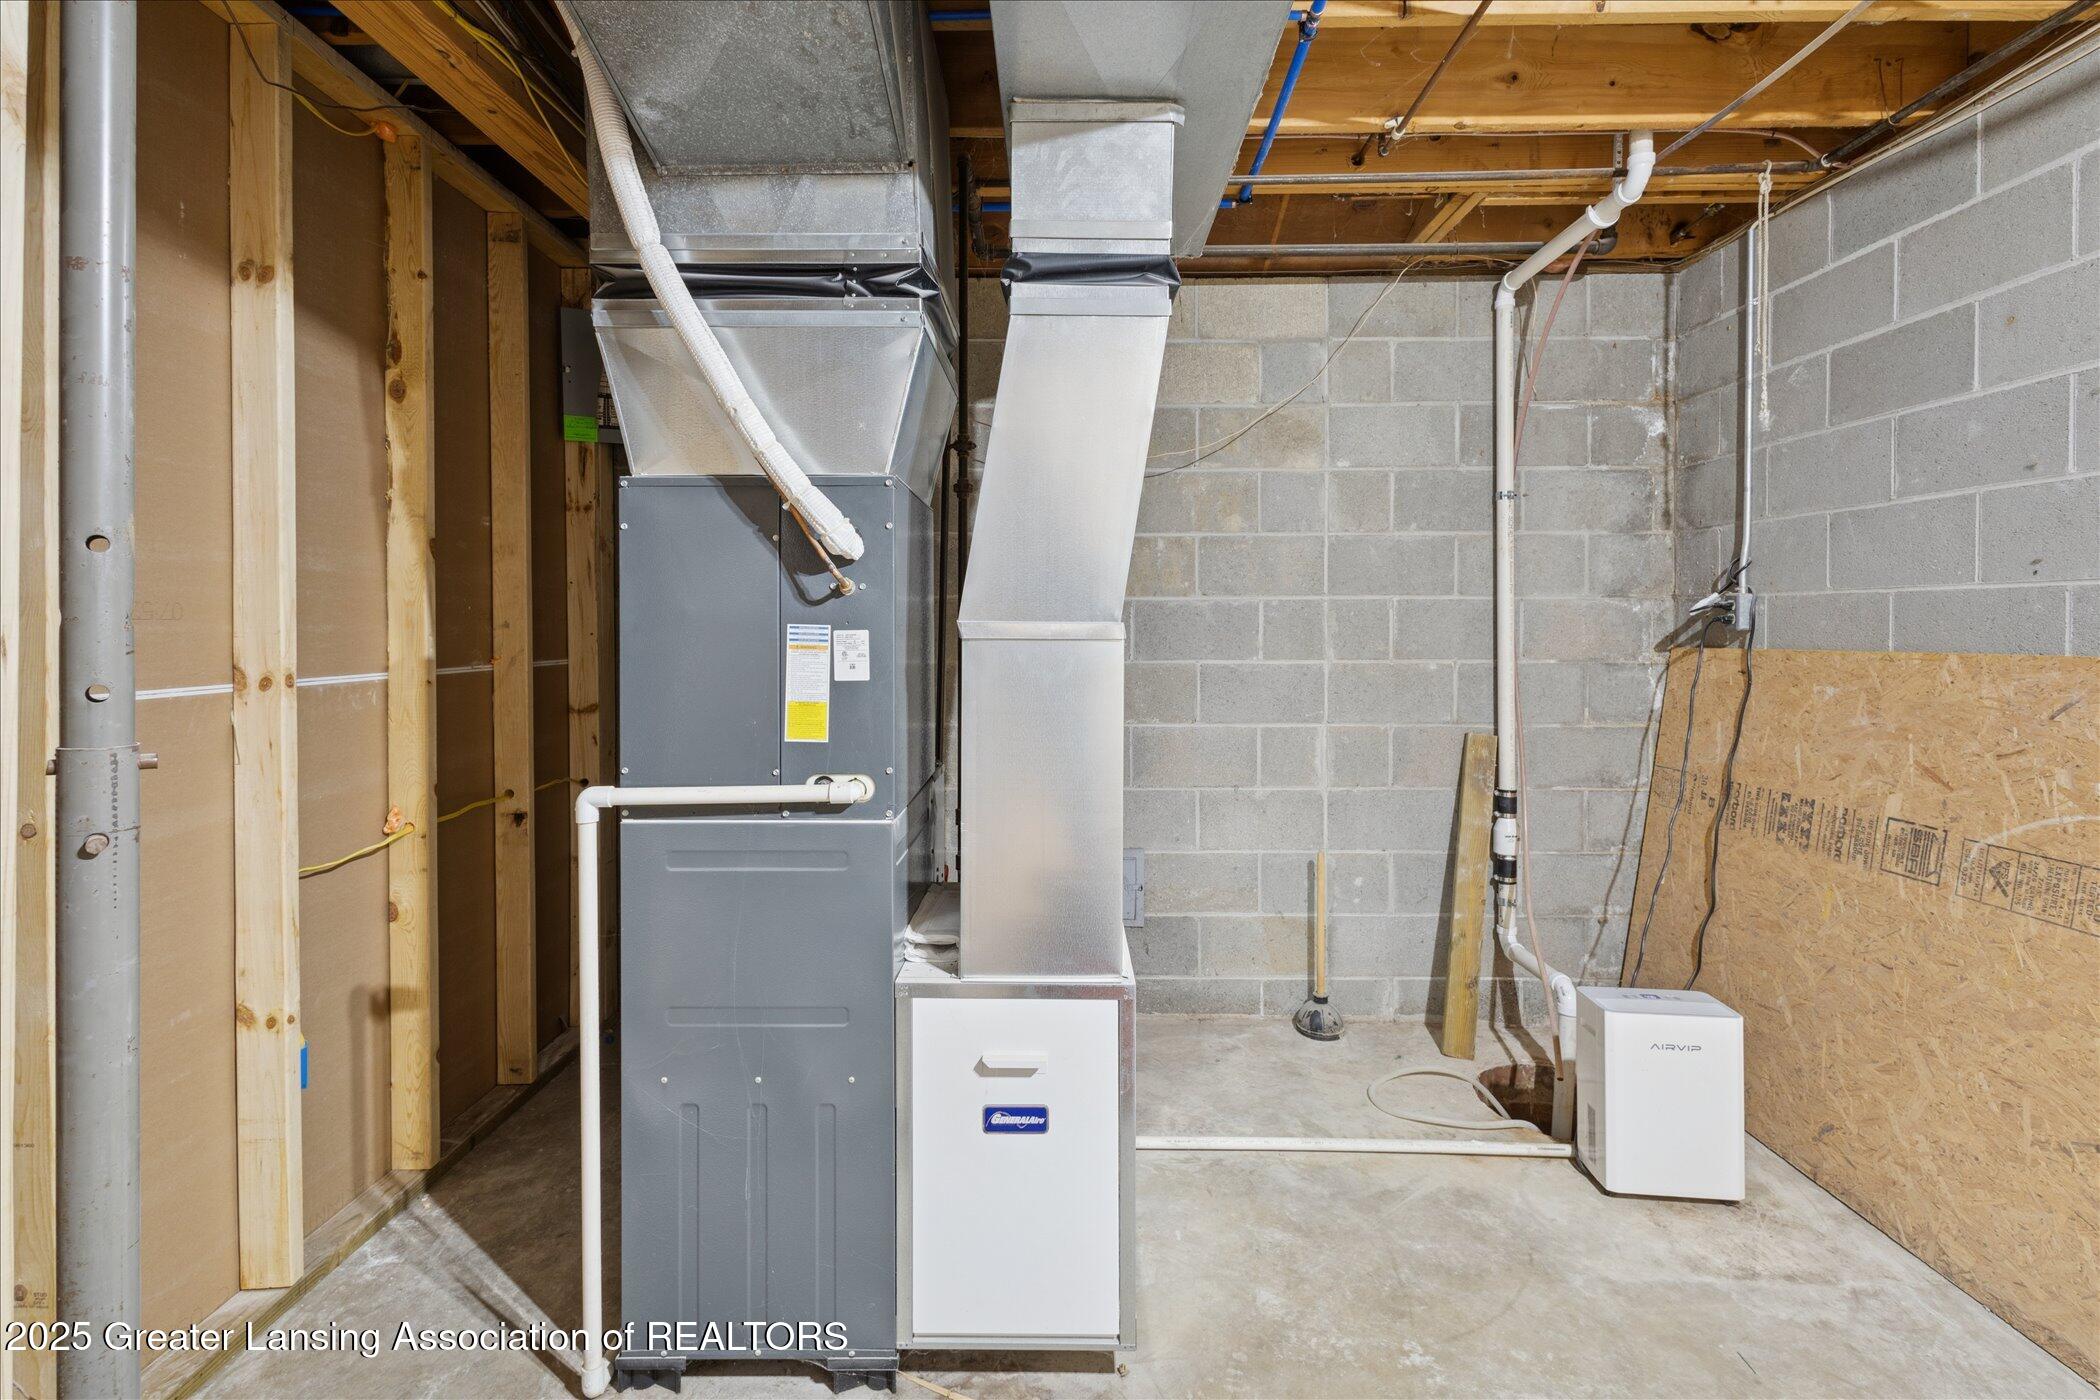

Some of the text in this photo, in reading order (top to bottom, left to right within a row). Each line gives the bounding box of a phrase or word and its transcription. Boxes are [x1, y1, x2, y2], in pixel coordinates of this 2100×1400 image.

[1907, 828, 1924, 875] SBA
[2049, 866, 2062, 913] EXPOSURE
[1650, 1043, 1702, 1052] AIRVIP
